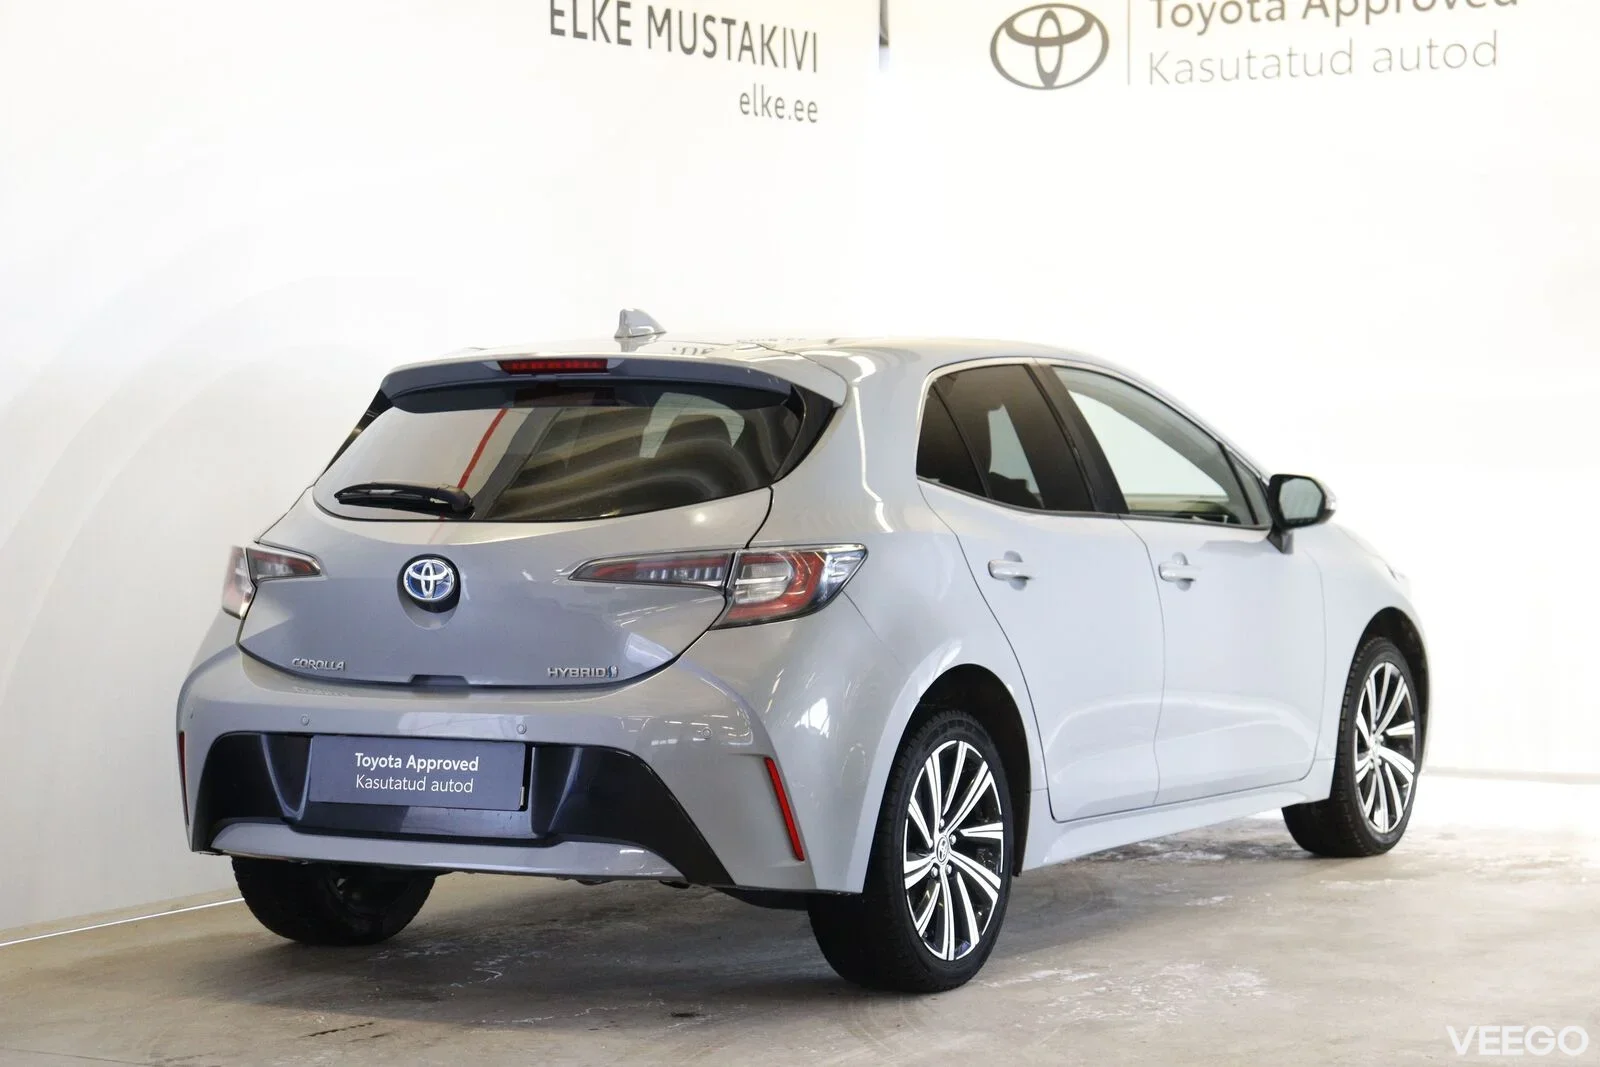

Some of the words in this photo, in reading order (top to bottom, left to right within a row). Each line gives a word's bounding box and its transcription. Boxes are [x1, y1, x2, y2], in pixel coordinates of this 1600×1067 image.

[1151, 0, 1286, 36] Toyota
[550, 0, 632, 46] ELKE
[647, 5, 817, 73] MUSTAKIVI
[1149, 36, 1353, 86] Kasutatud
[1372, 29, 1498, 73] autod
[739, 83, 818, 123] elke.ee
[291, 657, 346, 671] COROLLA
[547, 667, 606, 678] HYBRID
[355, 752, 402, 771] Toyota
[406, 754, 479, 773] Approved
[356, 774, 427, 791] Kasutatud
[430, 778, 474, 793] autod
